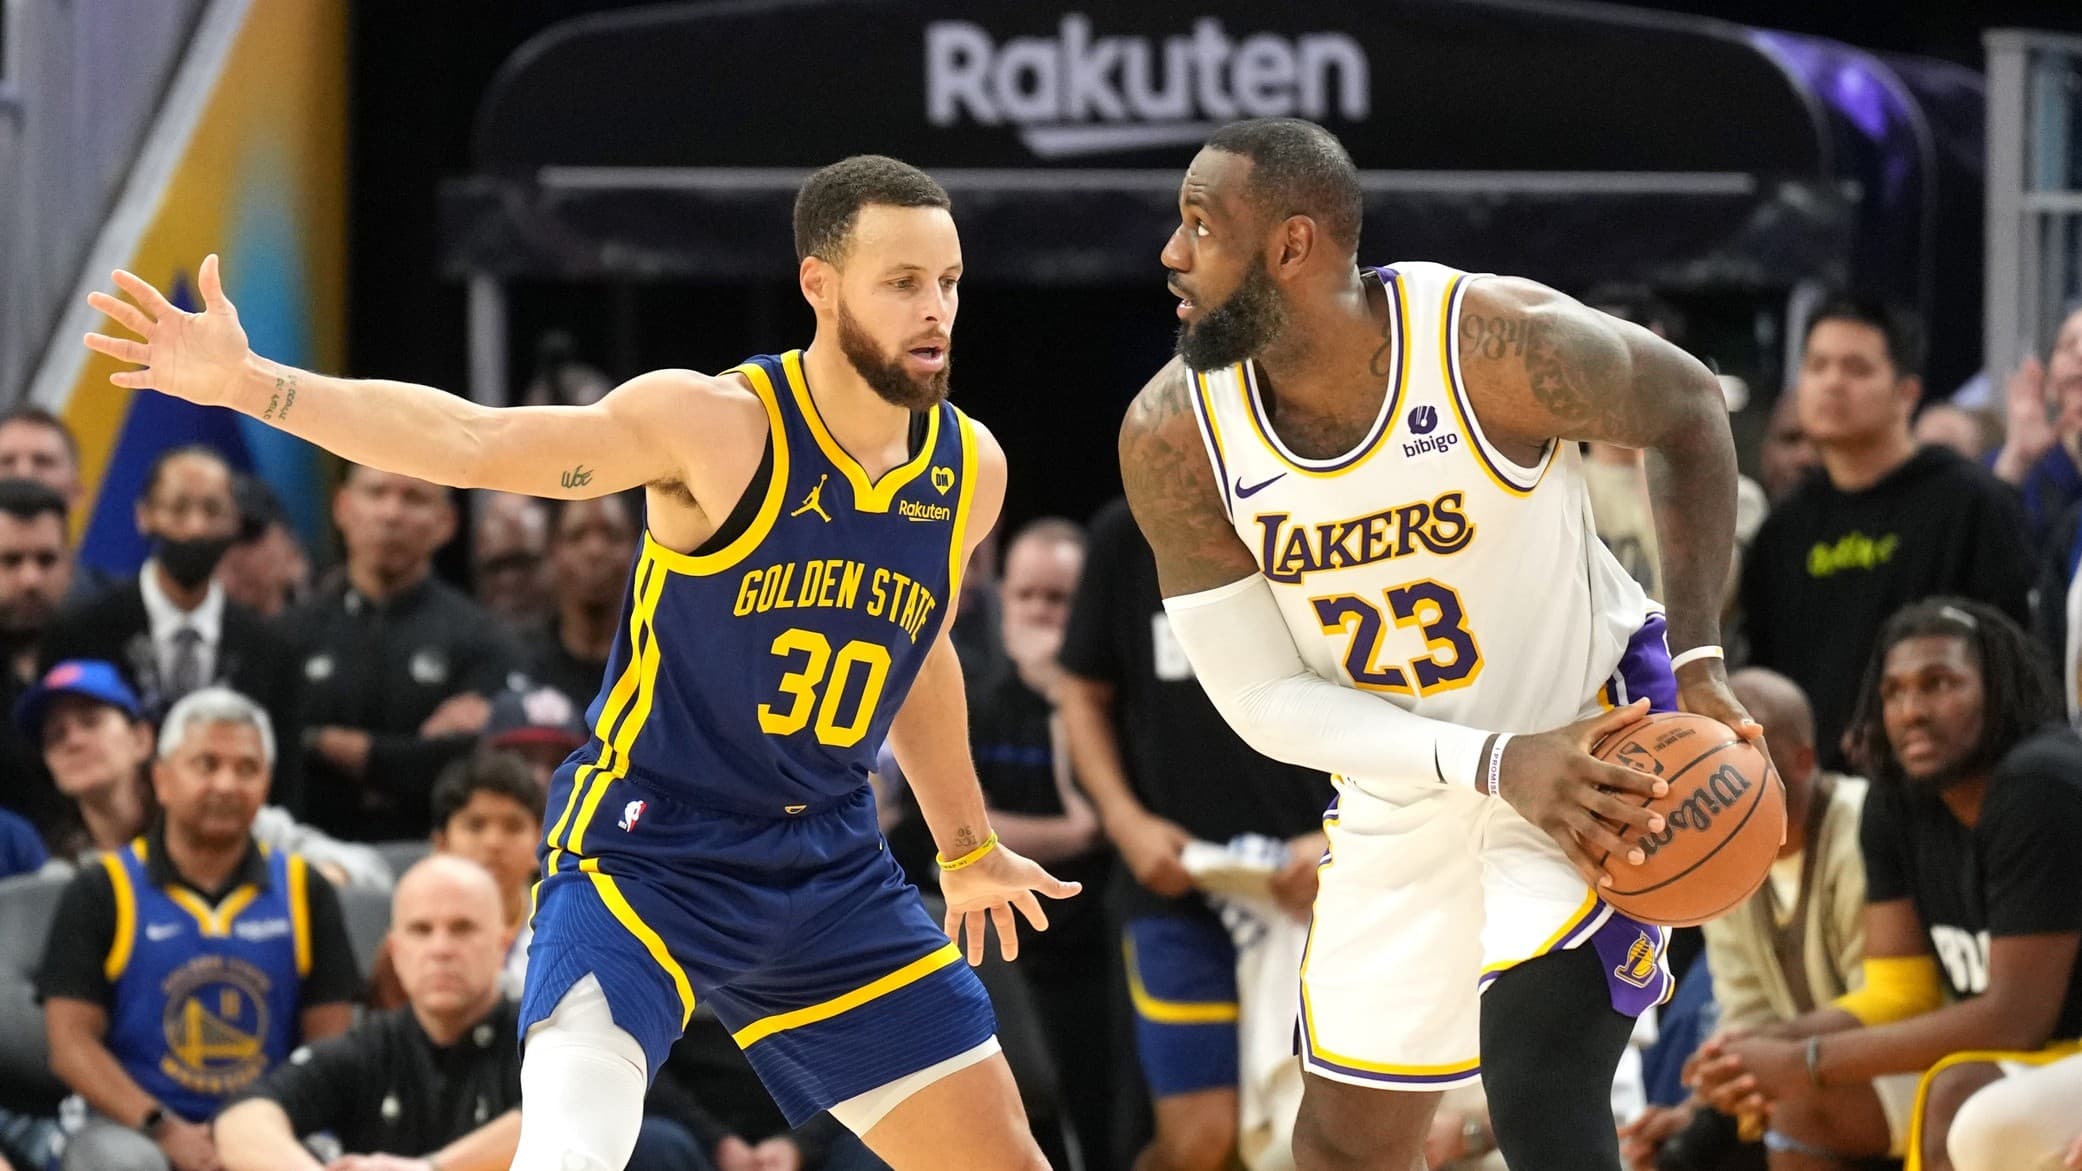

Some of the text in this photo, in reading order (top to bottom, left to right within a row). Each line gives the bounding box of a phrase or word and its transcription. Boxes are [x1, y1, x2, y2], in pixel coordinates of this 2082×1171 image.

[925, 13, 1369, 126] Rakuten
[936, 473, 949, 487] DM
[1402, 433, 1458, 458] bibigo
[899, 500, 950, 521] Rakuten
[1255, 490, 1476, 586] LAKERS
[733, 559, 936, 644] GOLDEN STATE
[1308, 577, 1485, 698] 23
[757, 628, 892, 748] 30
[1489, 753, 1499, 795] PROMISE
[1638, 764, 1751, 855] Wilson
